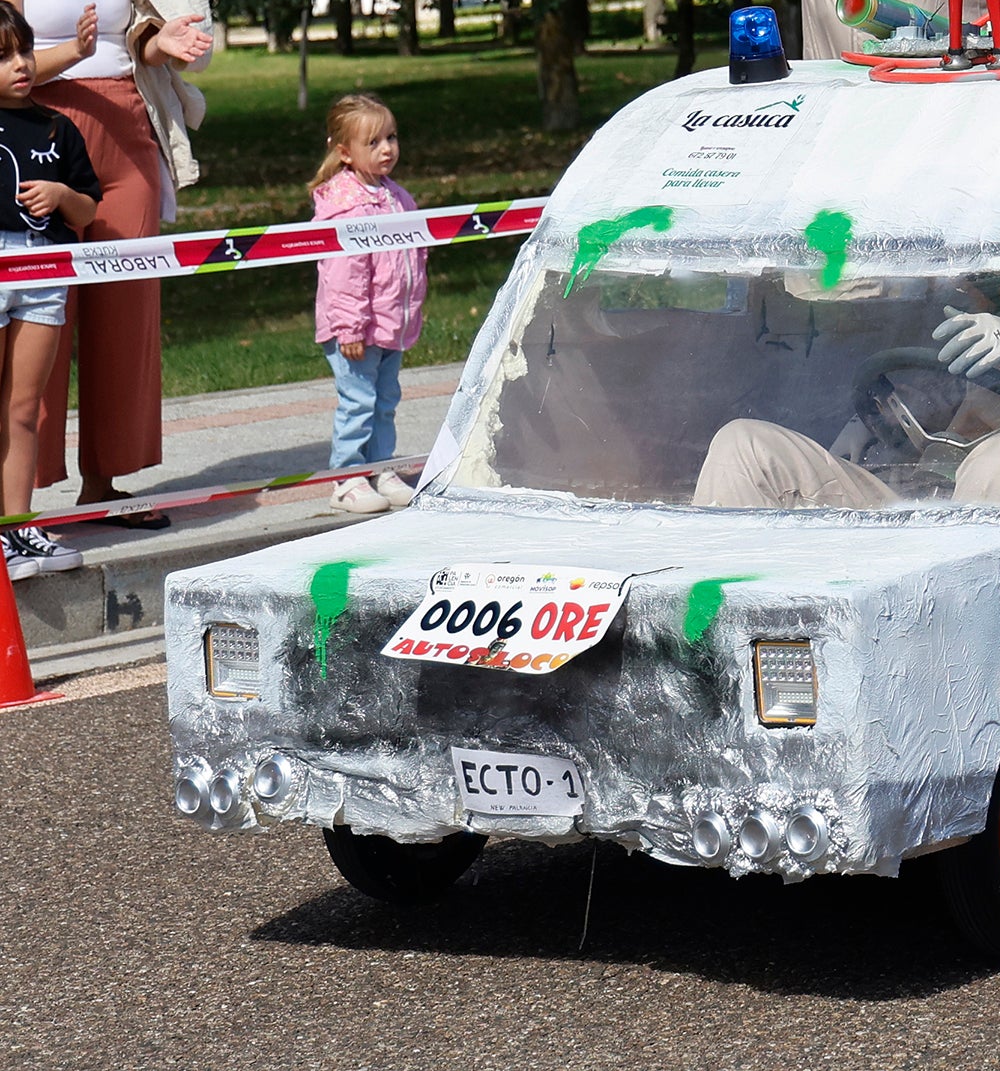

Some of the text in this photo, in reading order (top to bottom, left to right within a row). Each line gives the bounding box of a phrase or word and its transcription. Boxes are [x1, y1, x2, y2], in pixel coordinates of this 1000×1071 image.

[682, 110, 796, 132] La casuca
[662, 168, 704, 177] Comida
[661, 179, 692, 190] para
[346, 222, 378, 233] kutxa
[350, 231, 426, 248] LABORAL
[82, 244, 118, 257] kutxa
[85, 255, 171, 275] LABORAL
[497, 574, 525, 584] oregón
[589, 581, 620, 591] repso
[420, 599, 611, 642] 0006 ORE
